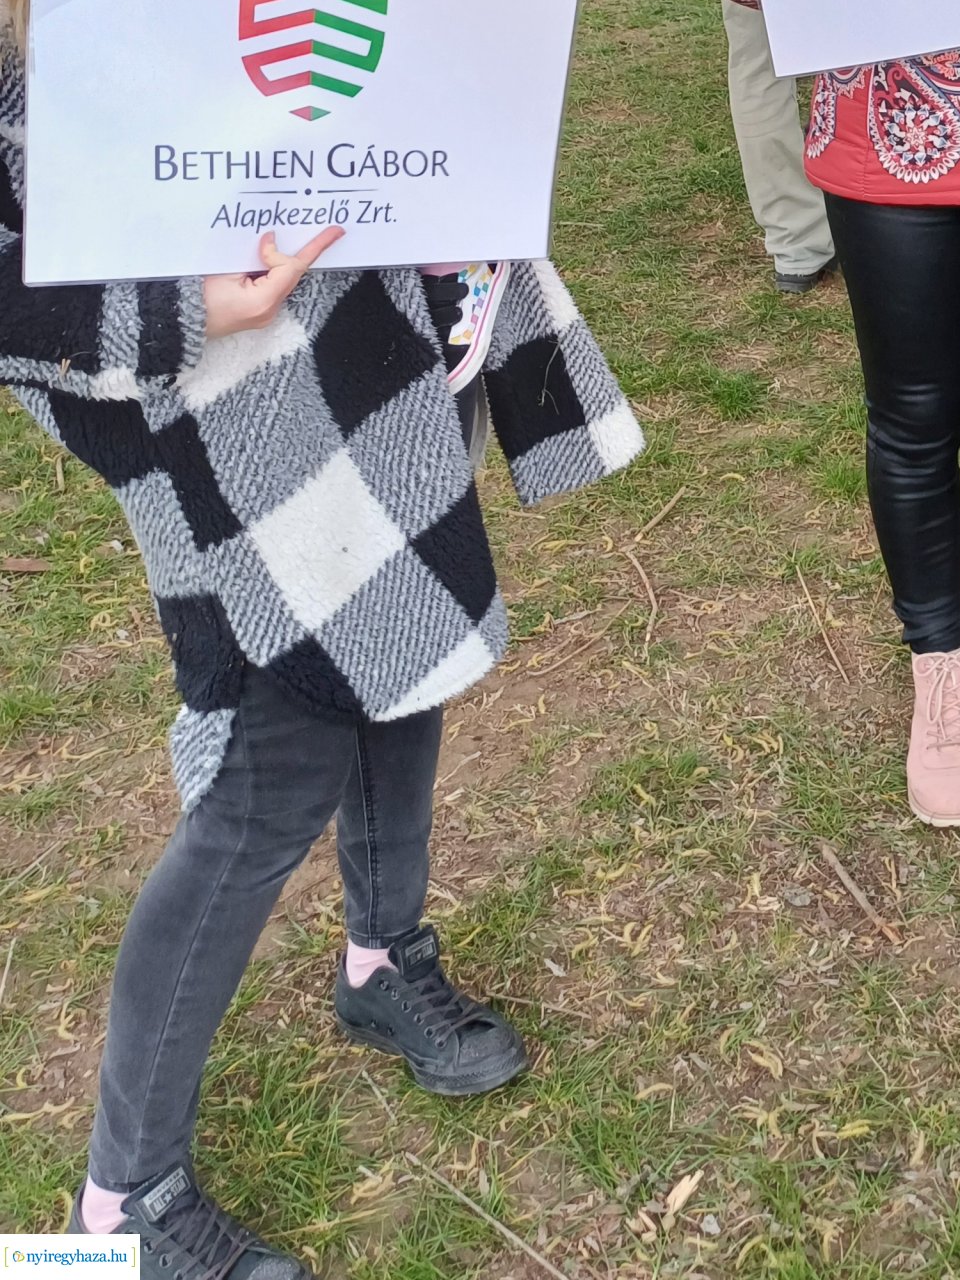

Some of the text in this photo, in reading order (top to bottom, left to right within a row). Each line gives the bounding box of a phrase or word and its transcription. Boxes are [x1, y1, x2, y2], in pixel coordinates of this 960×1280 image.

[154, 143, 450, 181] BETHLEN GÁBOR
[210, 200, 398, 234] Alapkezelő Zrt.
